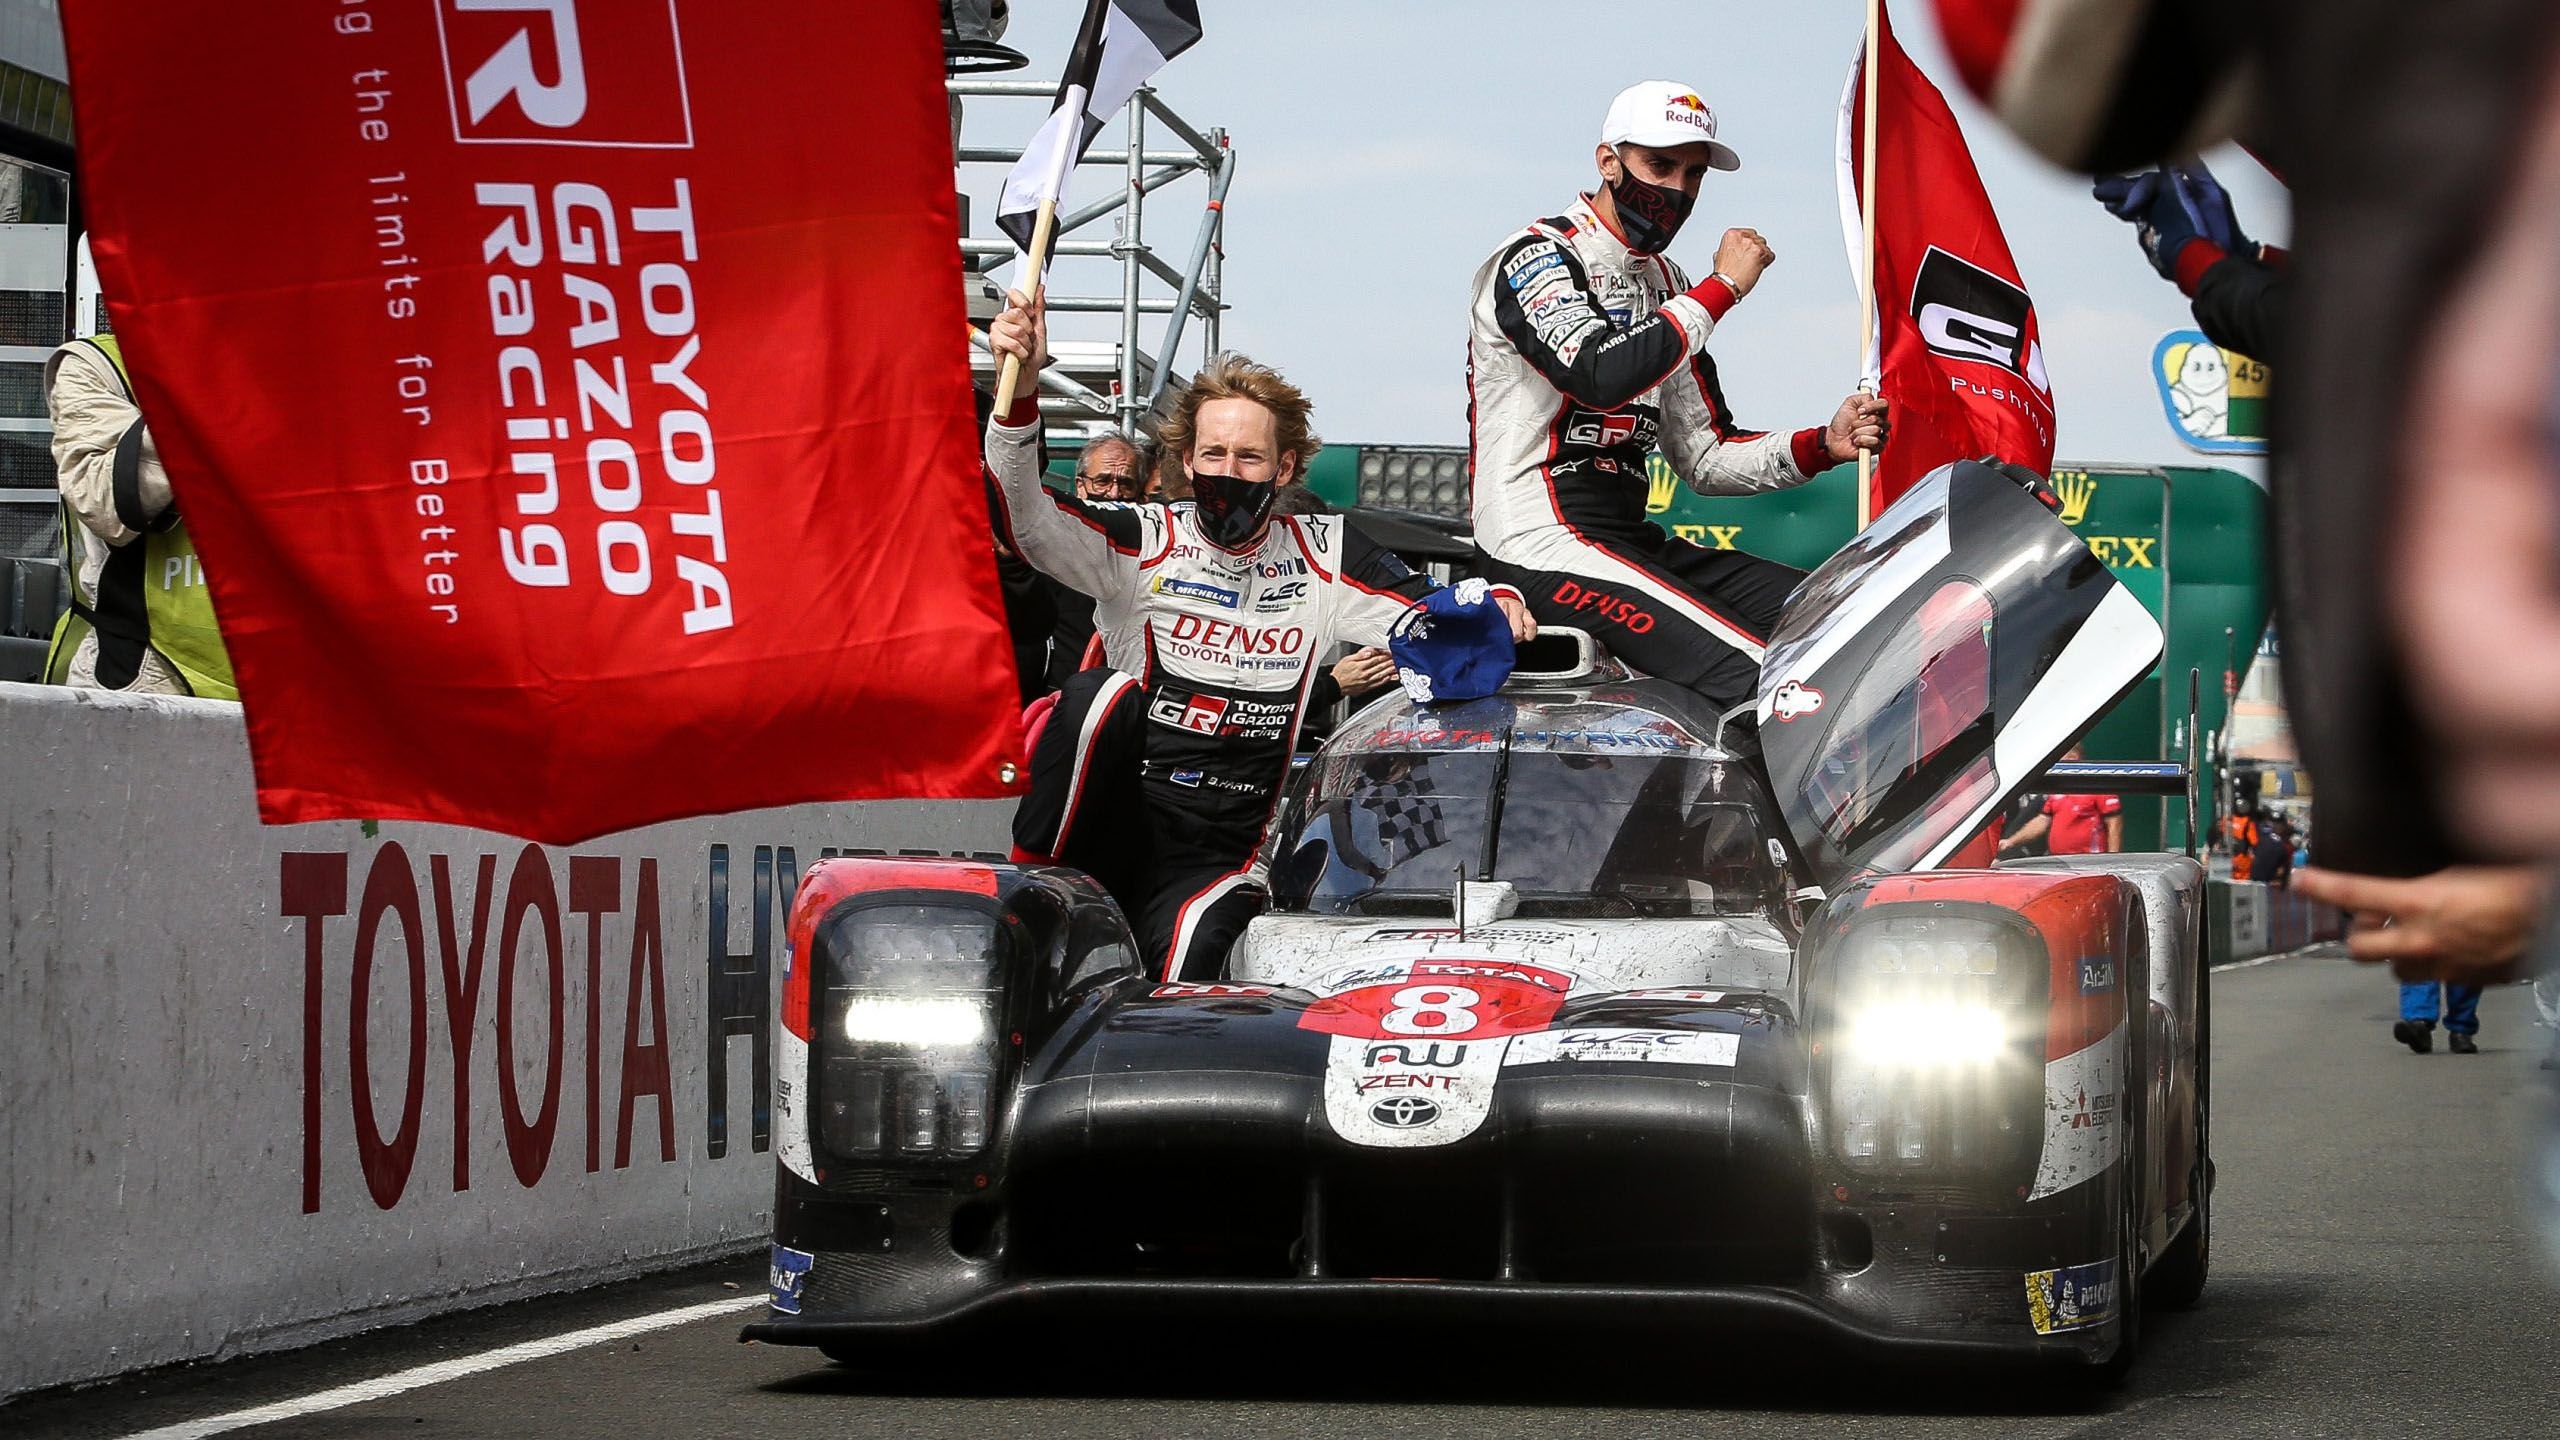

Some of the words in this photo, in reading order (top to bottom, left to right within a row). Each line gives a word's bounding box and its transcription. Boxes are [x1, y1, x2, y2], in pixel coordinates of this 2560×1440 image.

[352, 68, 392, 141] the
[1666, 110, 1693, 124] Red
[1694, 114, 1712, 136] Bull
[368, 171, 420, 320] limits
[1514, 256, 1558, 288] AISIN
[396, 354, 434, 427] for
[475, 182, 572, 588] Racing
[552, 182, 653, 597] GAZOO
[2235, 362, 2264, 385] 45
[631, 178, 734, 636] TOYOTA
[1951, 376, 2048, 448] Pushing
[409, 459, 460, 625] Better
[1175, 585, 1232, 605] MICHELIN
[1553, 580, 1656, 634] DENSO
[1169, 641, 1232, 666] TOYOTA
[1236, 656, 1301, 671] HYBRID
[1170, 613, 1304, 655] DENSO
[1151, 699, 1220, 733] GR
[1234, 699, 1296, 714] TOYOTA
[1231, 712, 1288, 726] GAZOO
[1366, 729, 1494, 746] TOYOTA
[1515, 730, 1682, 749] HYBRID
[1420, 964, 1559, 990] TOTAL
[281, 840, 676, 1214] TOYOTA
[1380, 984, 1481, 1036] 8
[1361, 1074, 1461, 1091] ZENT
